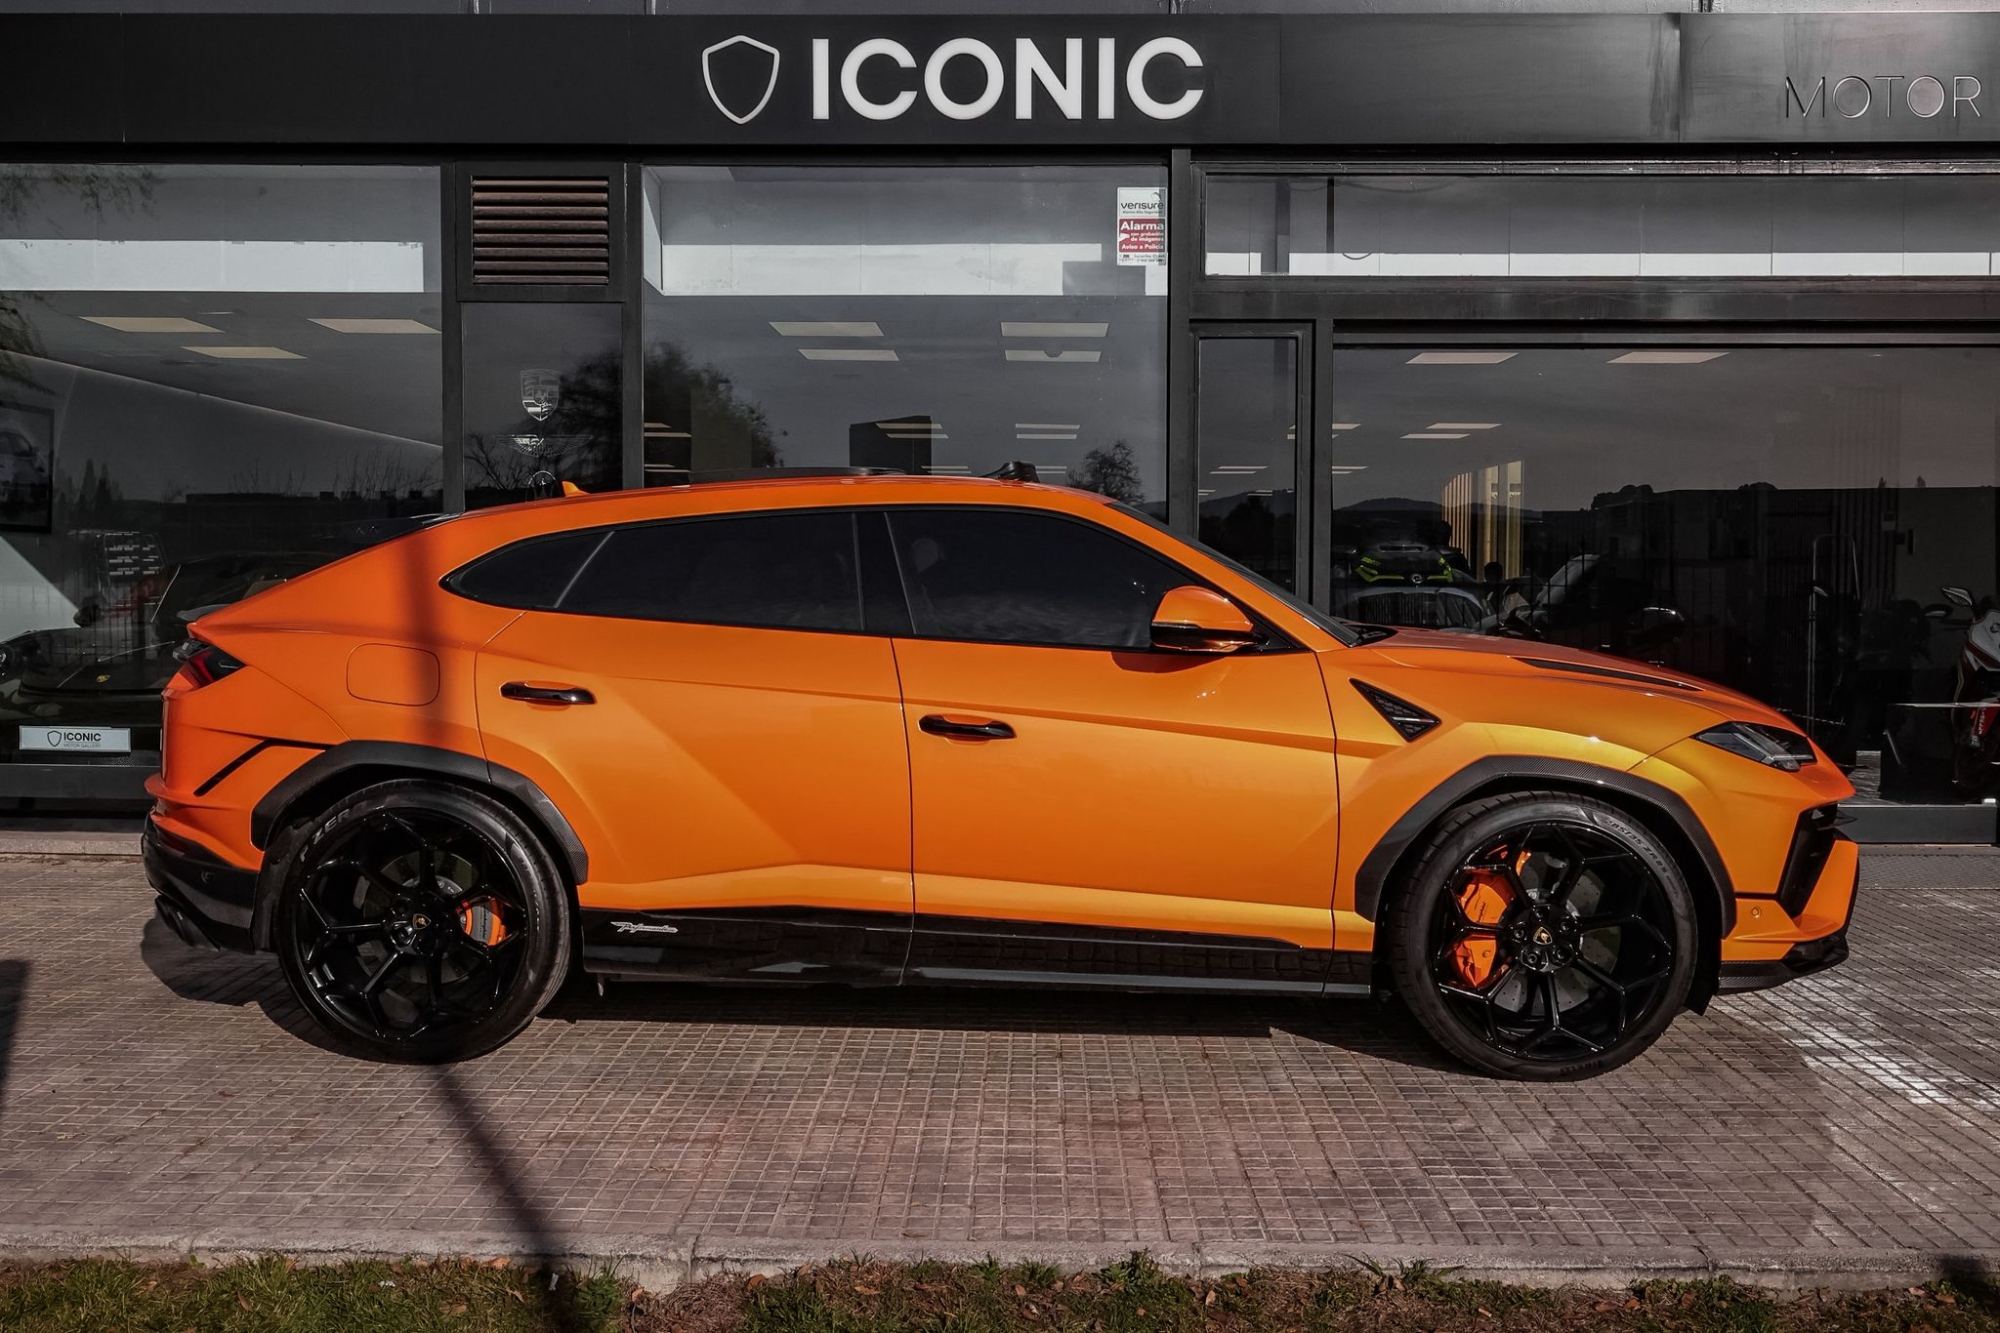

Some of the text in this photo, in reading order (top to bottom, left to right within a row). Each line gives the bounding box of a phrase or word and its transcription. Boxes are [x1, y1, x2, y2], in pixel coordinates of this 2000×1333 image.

[812, 36, 1204, 121] ICONIC
[1785, 75, 1981, 119] MOTOR
[1120, 202, 1164, 210] verisure
[1120, 220, 1164, 231] Alarma
[63, 732, 102, 742] ICONIC
